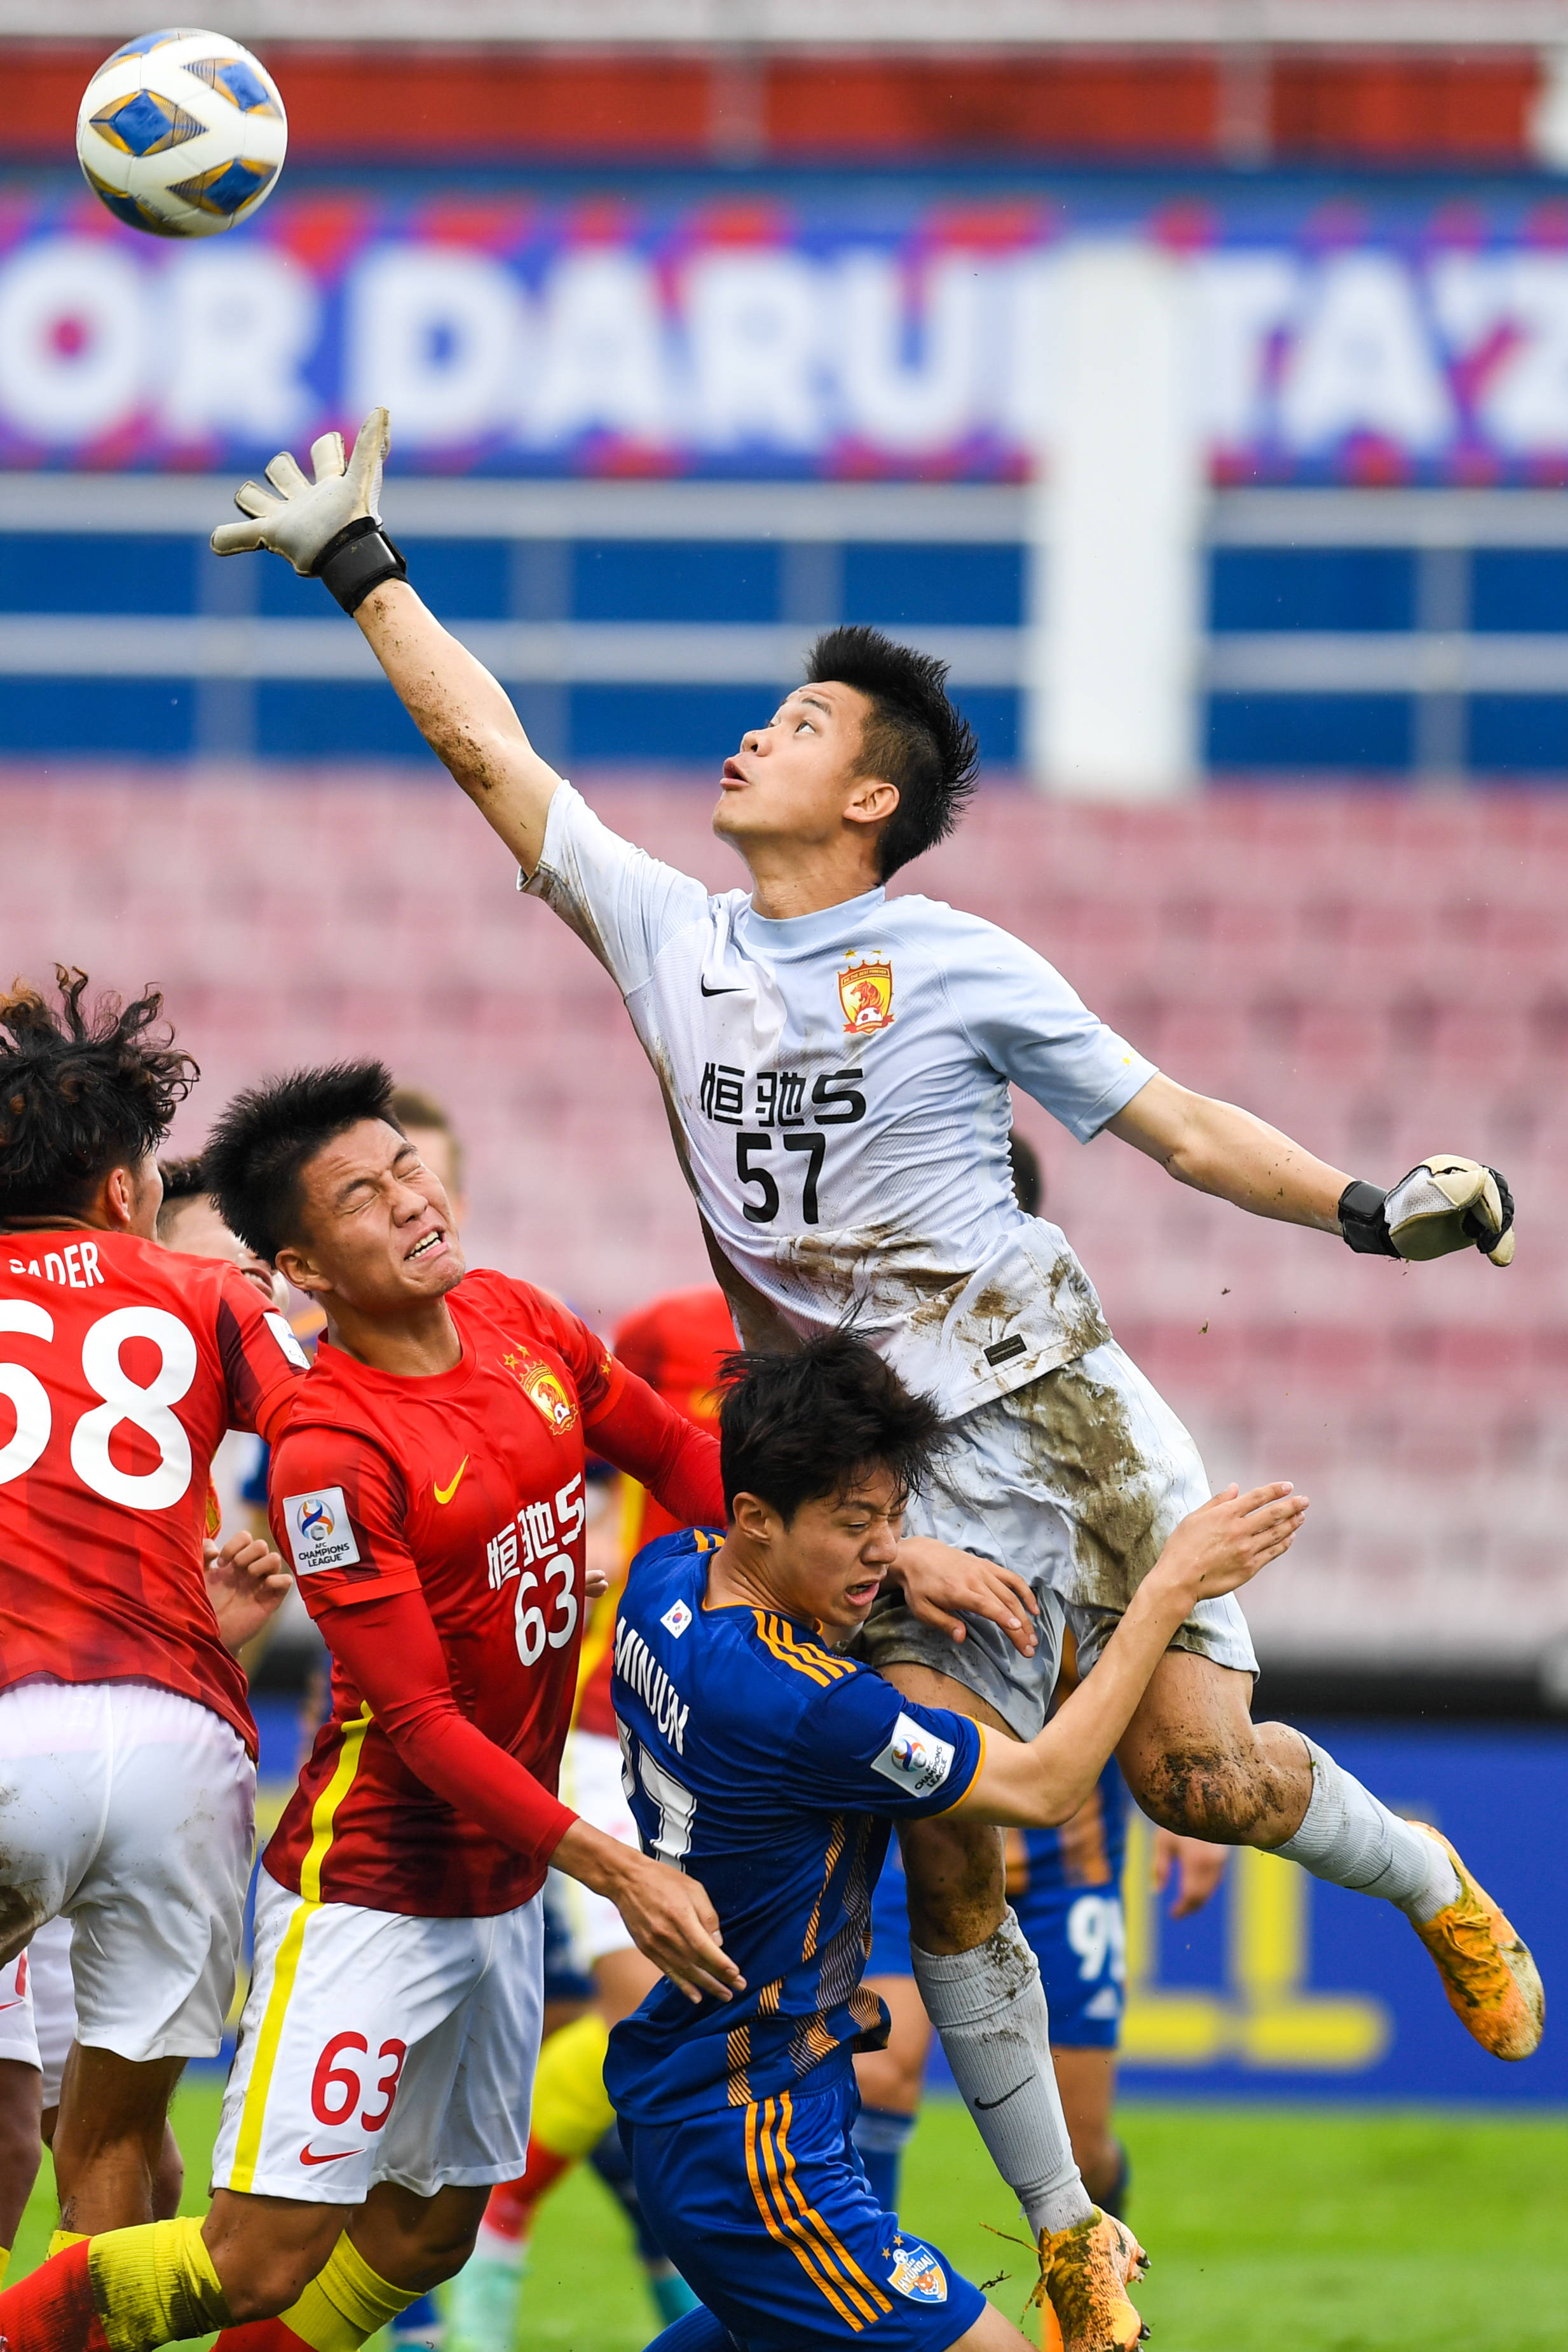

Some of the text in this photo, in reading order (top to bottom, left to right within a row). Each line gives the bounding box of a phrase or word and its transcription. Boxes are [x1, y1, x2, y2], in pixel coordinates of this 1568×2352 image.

[737, 1132, 826, 1224] 57
[298, 1543, 350, 1561] CHAMPIONS
[308, 1554, 343, 1568] LEAGUE
[514, 1553, 577, 1667] 63
[615, 1615, 690, 1756] MINJUN
[915, 1745, 943, 1790] CHAMPIONS
[927, 1758, 947, 1788] LEAGUE
[310, 2031, 407, 2132] 63
[897, 2253, 935, 2292] HYUNDAI
